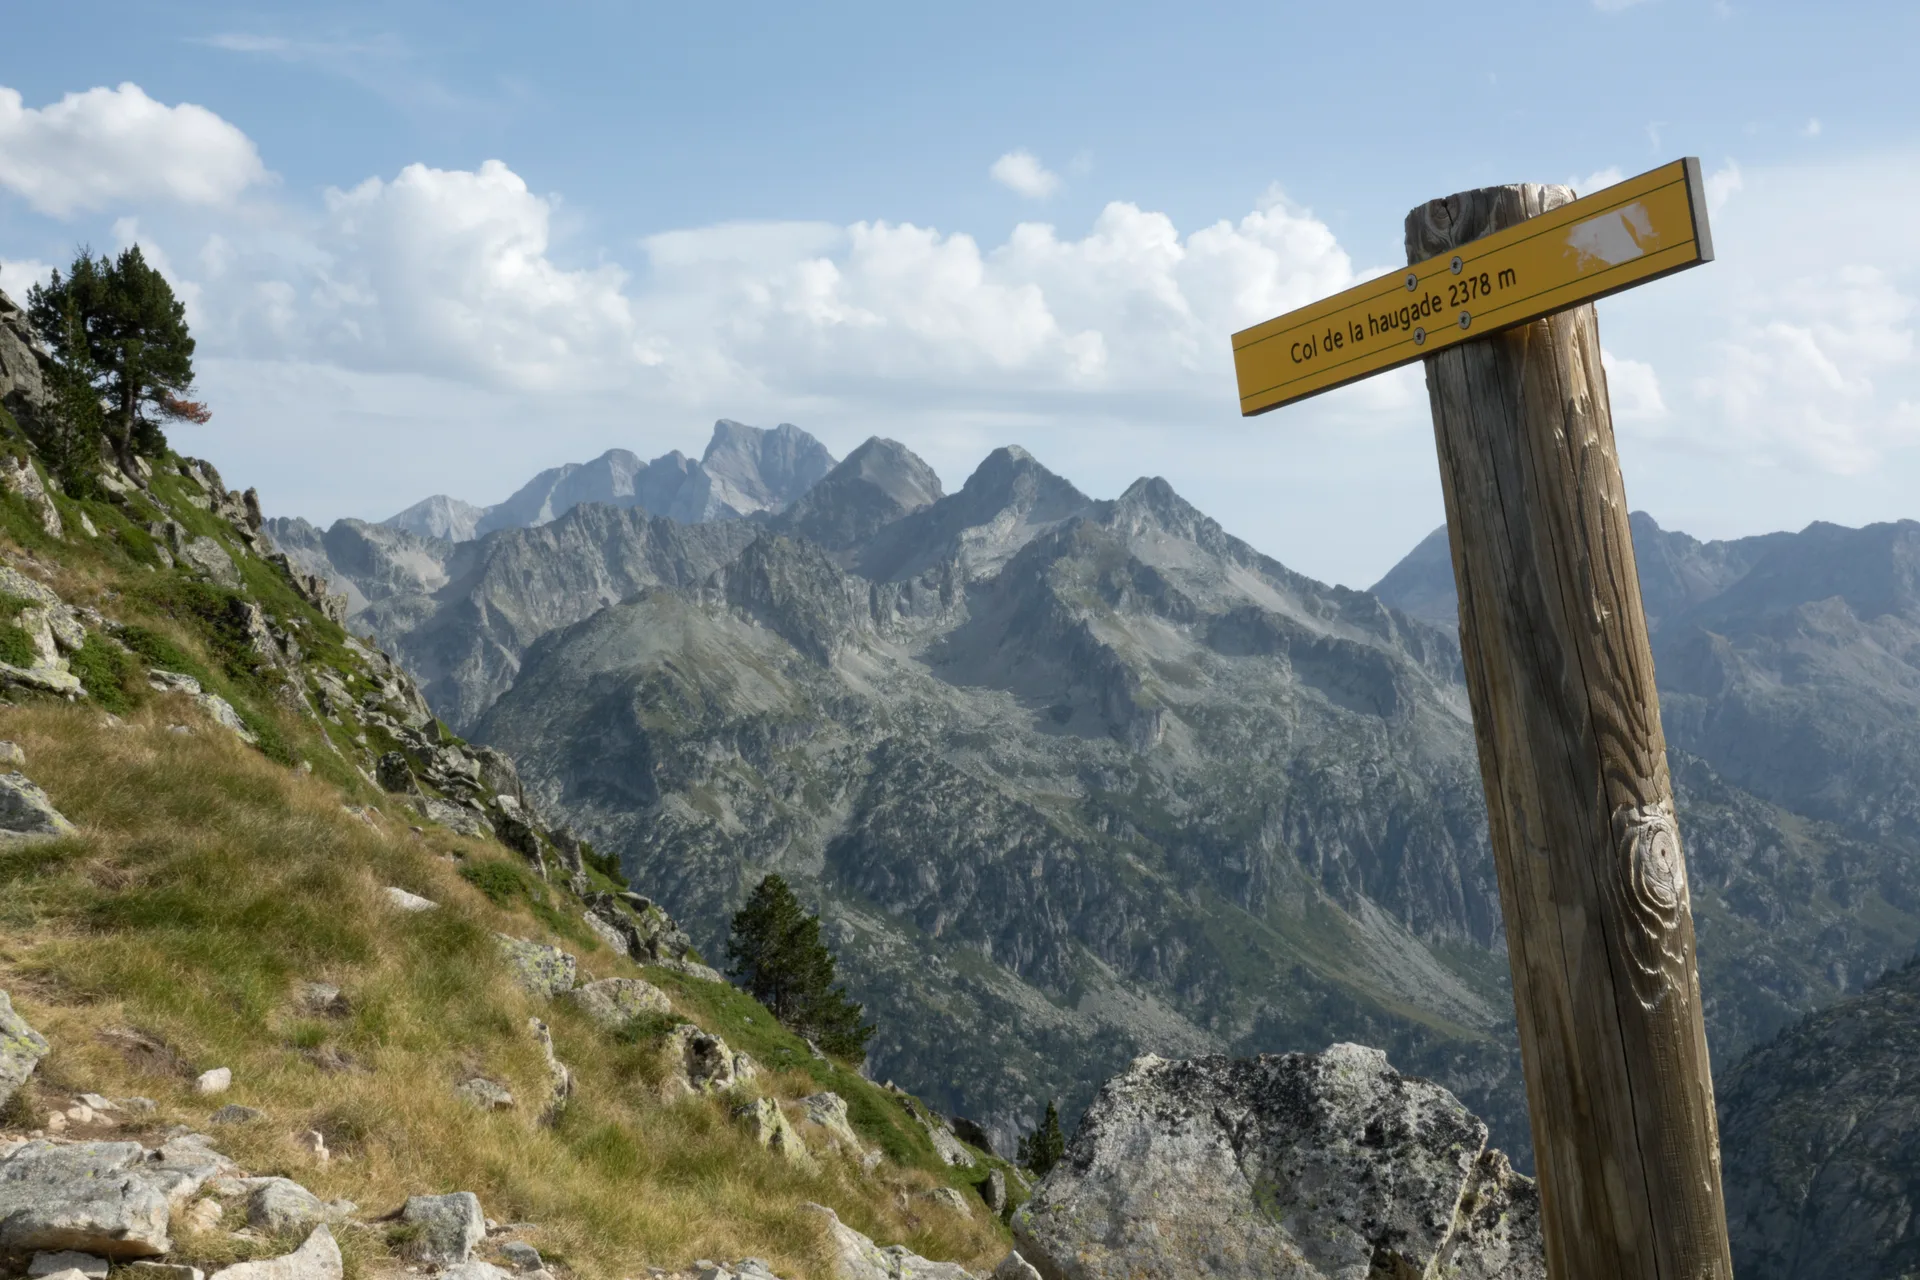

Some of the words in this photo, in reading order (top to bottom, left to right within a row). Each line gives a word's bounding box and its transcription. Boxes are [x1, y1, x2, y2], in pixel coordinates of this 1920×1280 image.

[1290, 334, 1318, 364] Col
[1323, 328, 1343, 352] de
[1348, 320, 1364, 343] la
[1368, 292, 1443, 336] haugade
[1448, 272, 1492, 308] 2378
[1497, 267, 1517, 290] m
